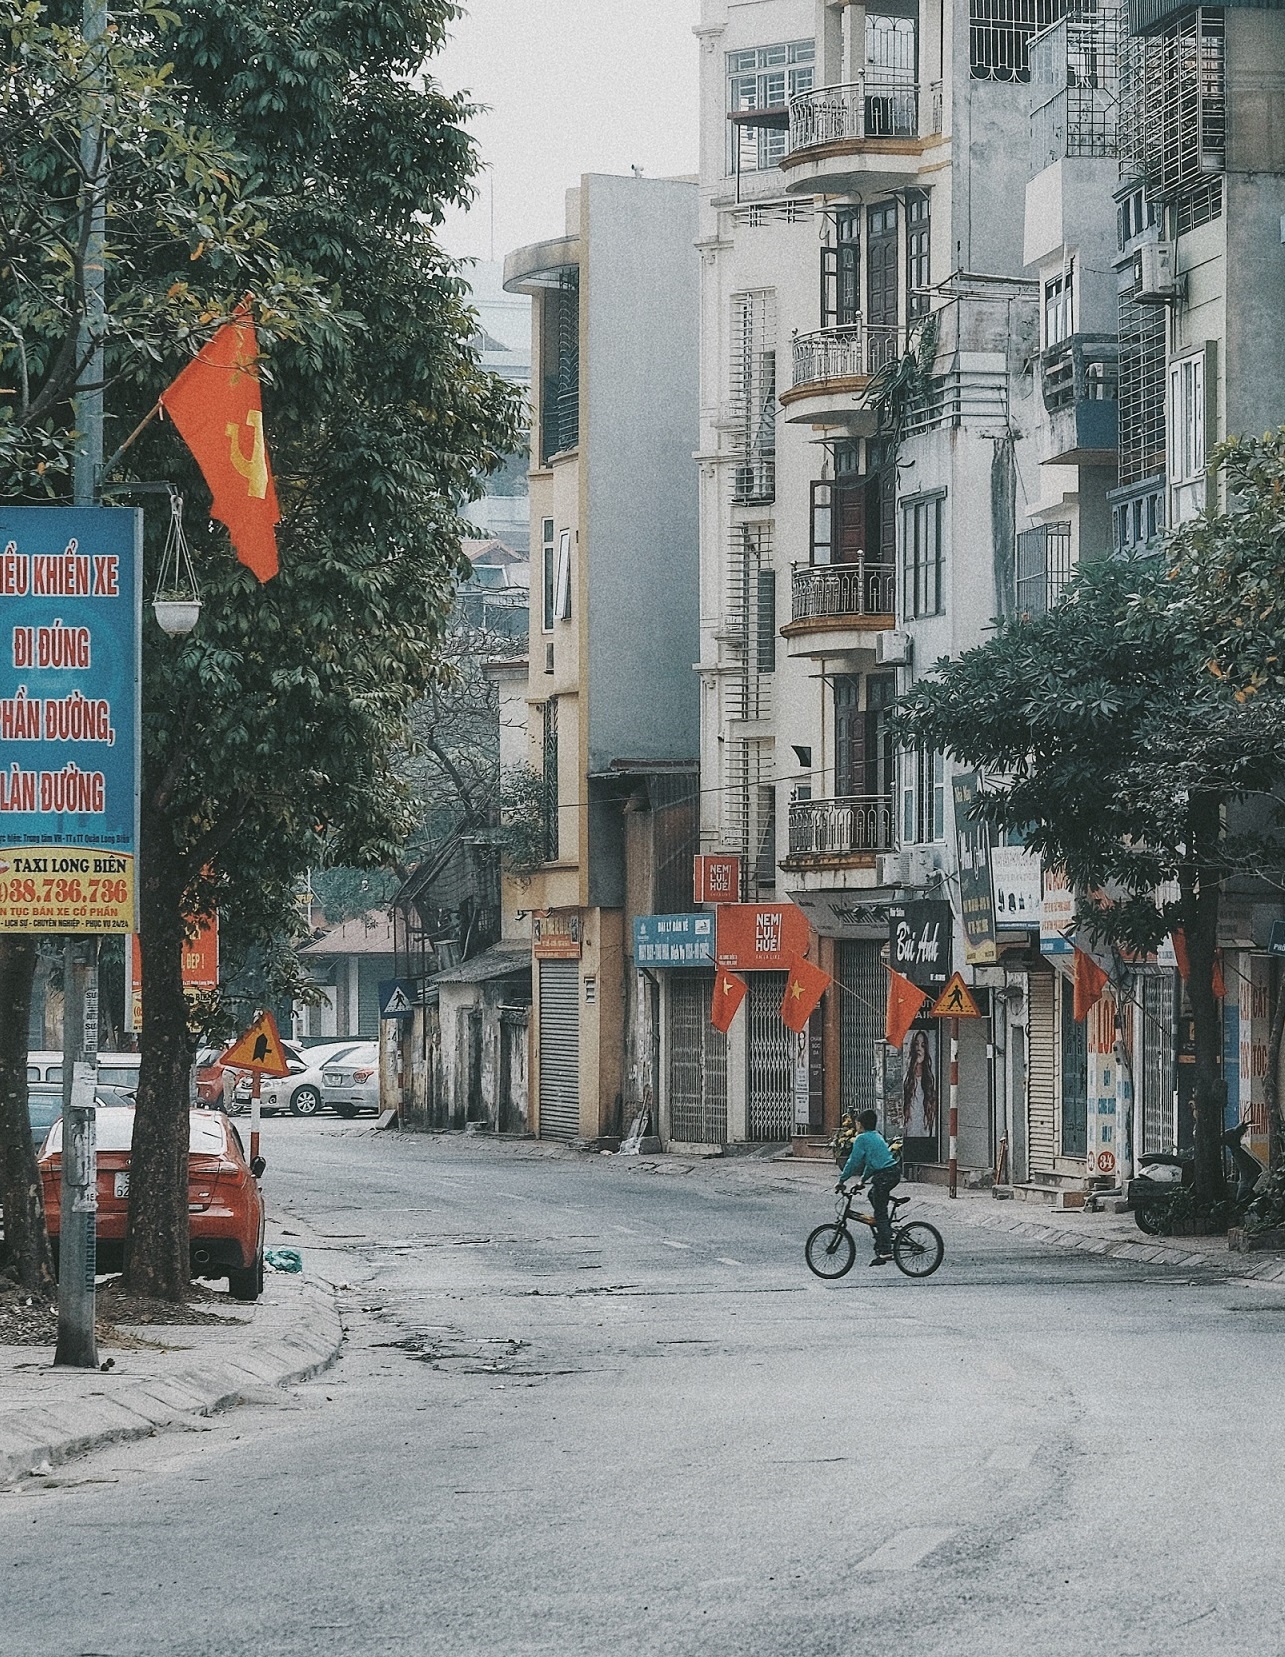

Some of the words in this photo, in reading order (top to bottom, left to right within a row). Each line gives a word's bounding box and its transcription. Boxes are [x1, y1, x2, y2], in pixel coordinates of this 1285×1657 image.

[0, 541, 29, 596] IỀU
[32, 538, 90, 596] KHIỂN
[92, 555, 119, 597] XE
[13, 627, 34, 668] ĐI
[37, 618, 91, 669] ĐÚNG
[0, 685, 41, 741] HẦN
[45, 689, 115, 746] ĐƯỜNG,
[0, 762, 37, 813] LÀN
[40, 761, 105, 813] ĐƯỜNG
[13, 858, 48, 873] TAXI
[51, 858, 90, 873] LONG
[93, 855, 127, 873] BIÊN
[710, 865, 729, 874] NEM
[0, 878, 128, 904] )38.736.736
[10, 907, 29, 918] TỤC
[32, 906, 54, 916] BÁN
[56, 907, 70, 916] XE
[73, 905, 88, 916] CỔ
[90, 905, 118, 917] PHẦN
[756, 913, 779, 926] NEM
[112, 919, 129, 928] 24/24
